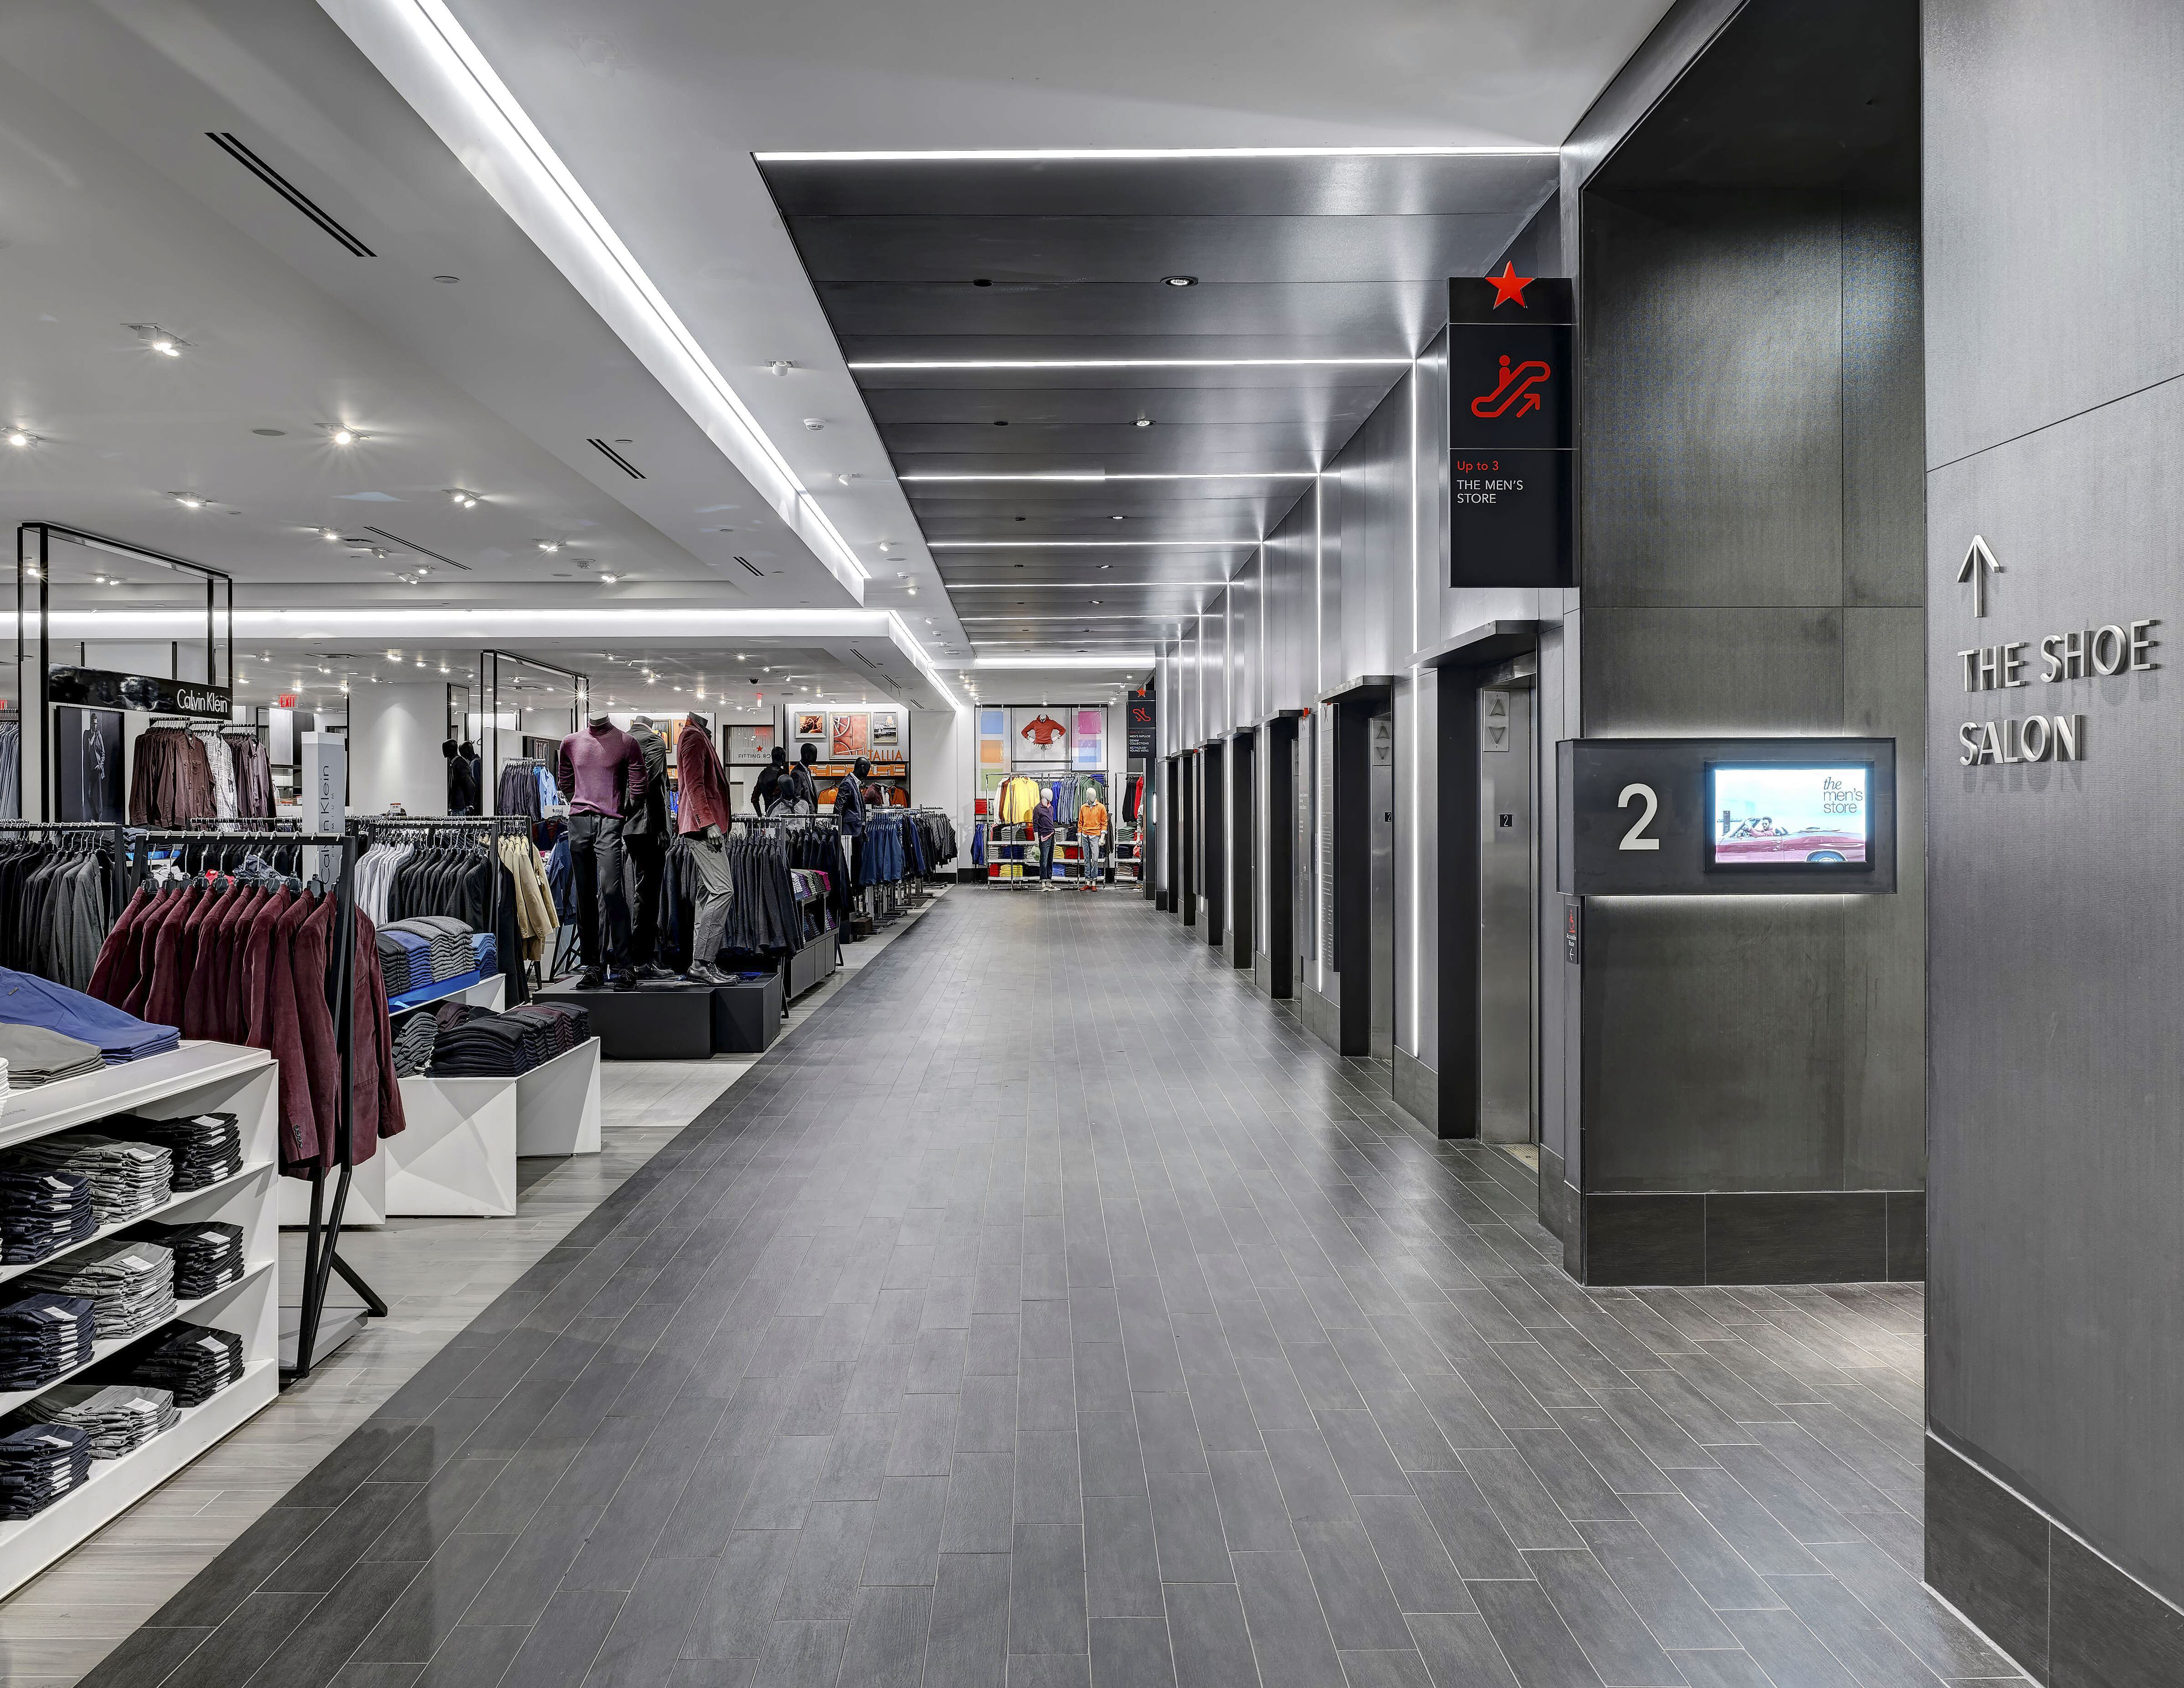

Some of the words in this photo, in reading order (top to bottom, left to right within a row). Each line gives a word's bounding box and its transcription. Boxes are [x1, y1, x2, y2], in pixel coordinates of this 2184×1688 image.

[1457, 460, 1473, 474] Up
[1476, 462, 1488, 470] to
[1492, 460, 1499, 470] 3
[1456, 480, 1481, 490] THE
[1485, 480, 1523, 491] MEN'S
[1457, 493, 1497, 503] STORE
[1957, 642, 2027, 692] THE
[2040, 620, 2158, 683] SHOE
[177, 689, 206, 710] Calvin
[207, 691, 228, 713] Klein
[280, 695, 297, 708] EXIT
[1959, 714, 2083, 766] SALON
[868, 750, 903, 761] TALLIA
[320, 765, 330, 814] Klein
[1823, 776, 1842, 790] the
[1823, 788, 1863, 801] men's
[1823, 801, 1857, 814] store
[1387, 812, 1392, 822] 2
[1503, 815, 1509, 827] 2
[1618, 783, 1660, 850] 2
